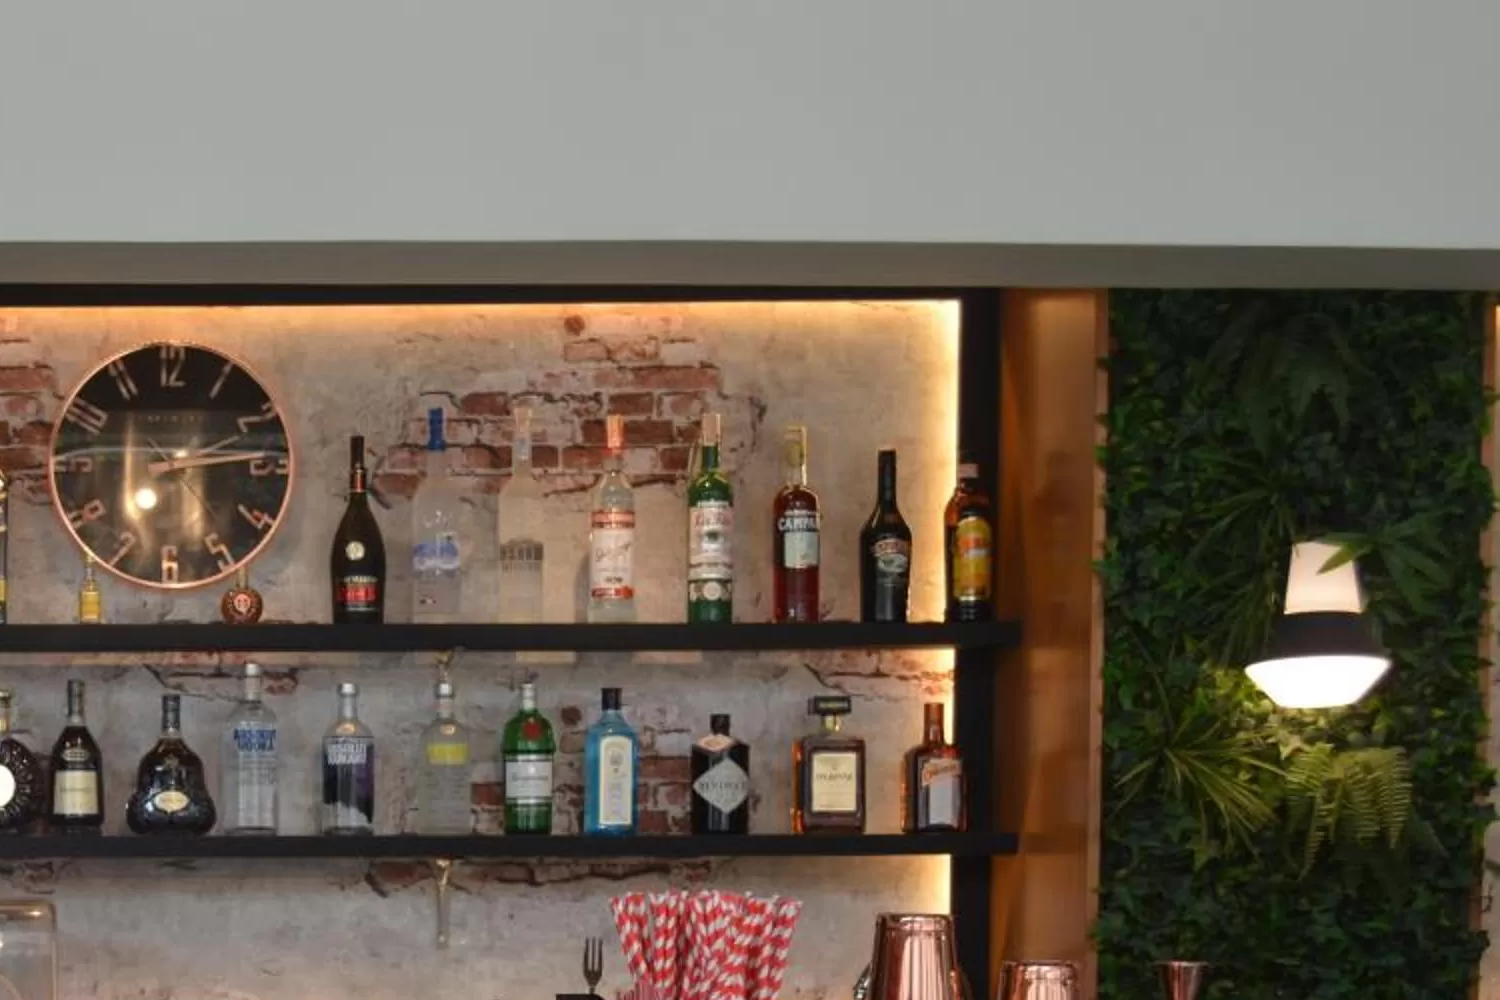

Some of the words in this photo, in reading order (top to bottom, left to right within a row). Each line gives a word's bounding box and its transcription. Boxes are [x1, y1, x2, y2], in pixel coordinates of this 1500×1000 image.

[159, 345, 186, 387] 12
[209, 361, 235, 399] 1
[236, 402, 277, 433] 2
[108, 532, 136, 567] 7
[161, 545, 179, 583] 6
[204, 531, 236, 572] 5
